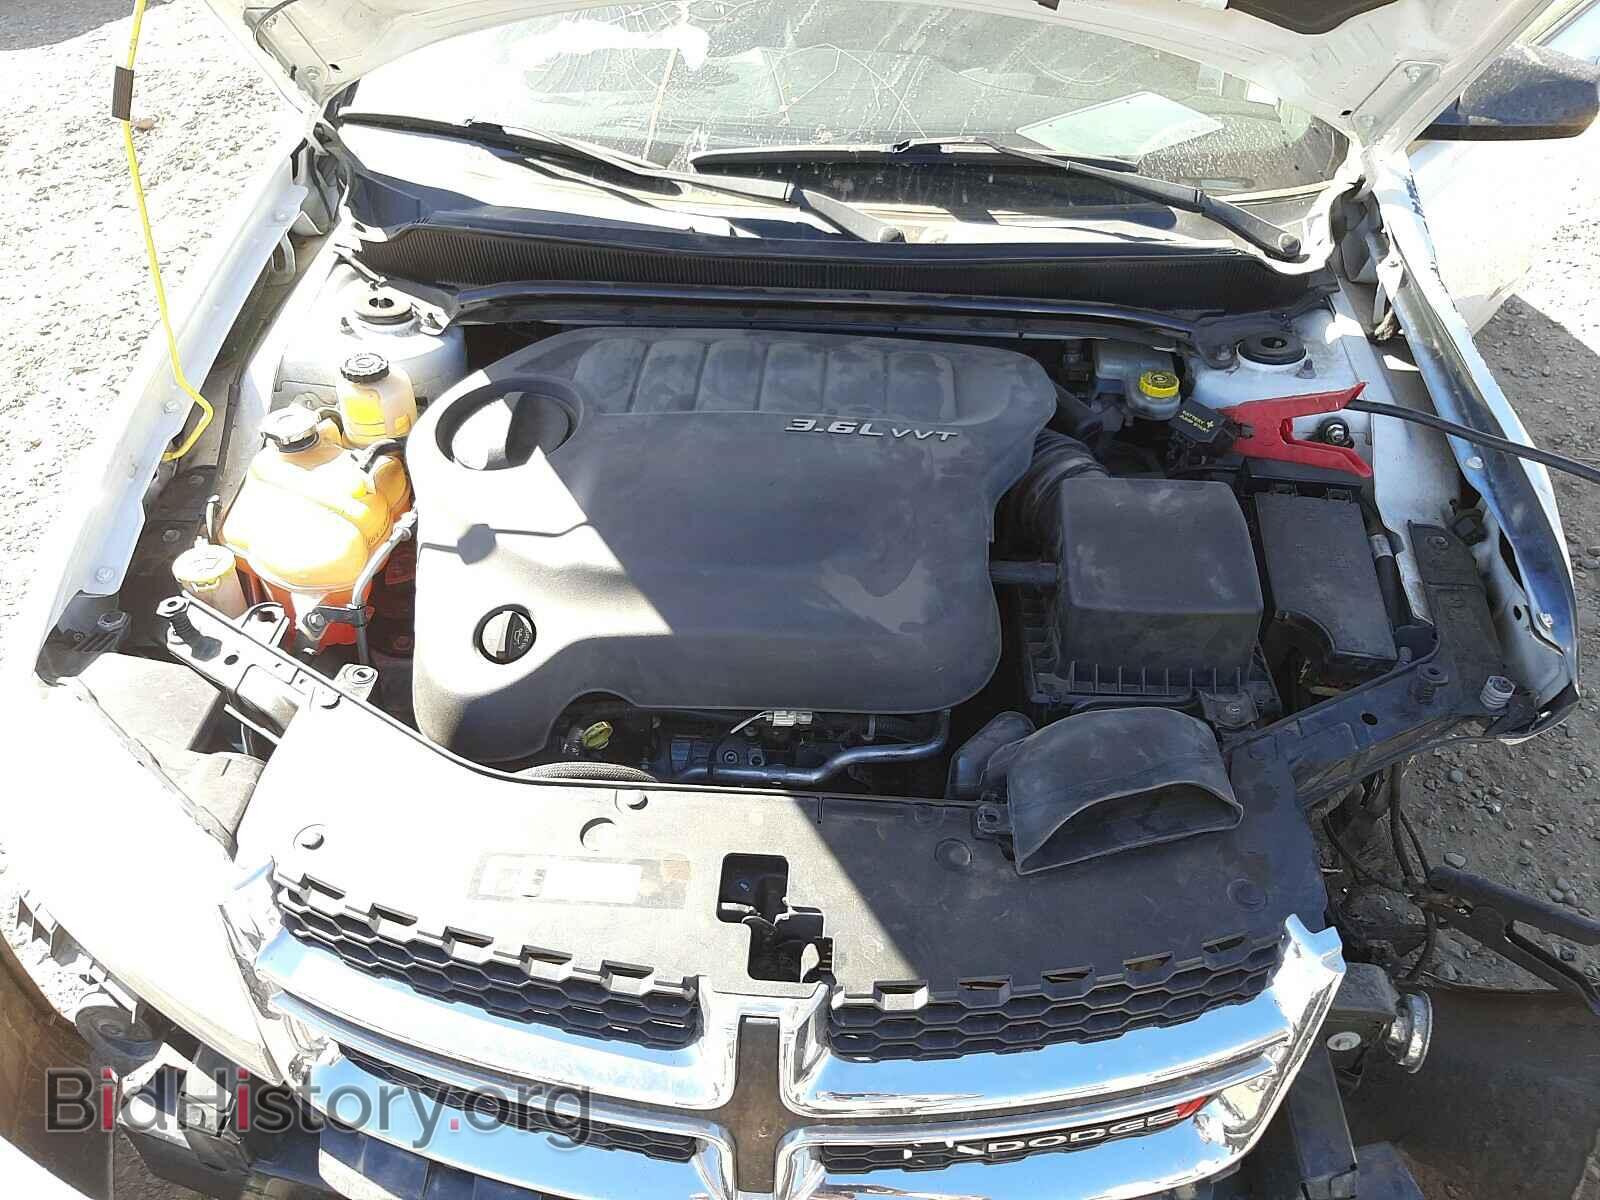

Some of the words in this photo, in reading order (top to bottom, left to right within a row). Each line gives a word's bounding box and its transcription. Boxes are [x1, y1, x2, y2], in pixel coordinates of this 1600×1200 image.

[785, 418, 884, 436] 3.6L
[891, 427, 959, 441] VVT
[988, 1110, 1181, 1153] DODGE
